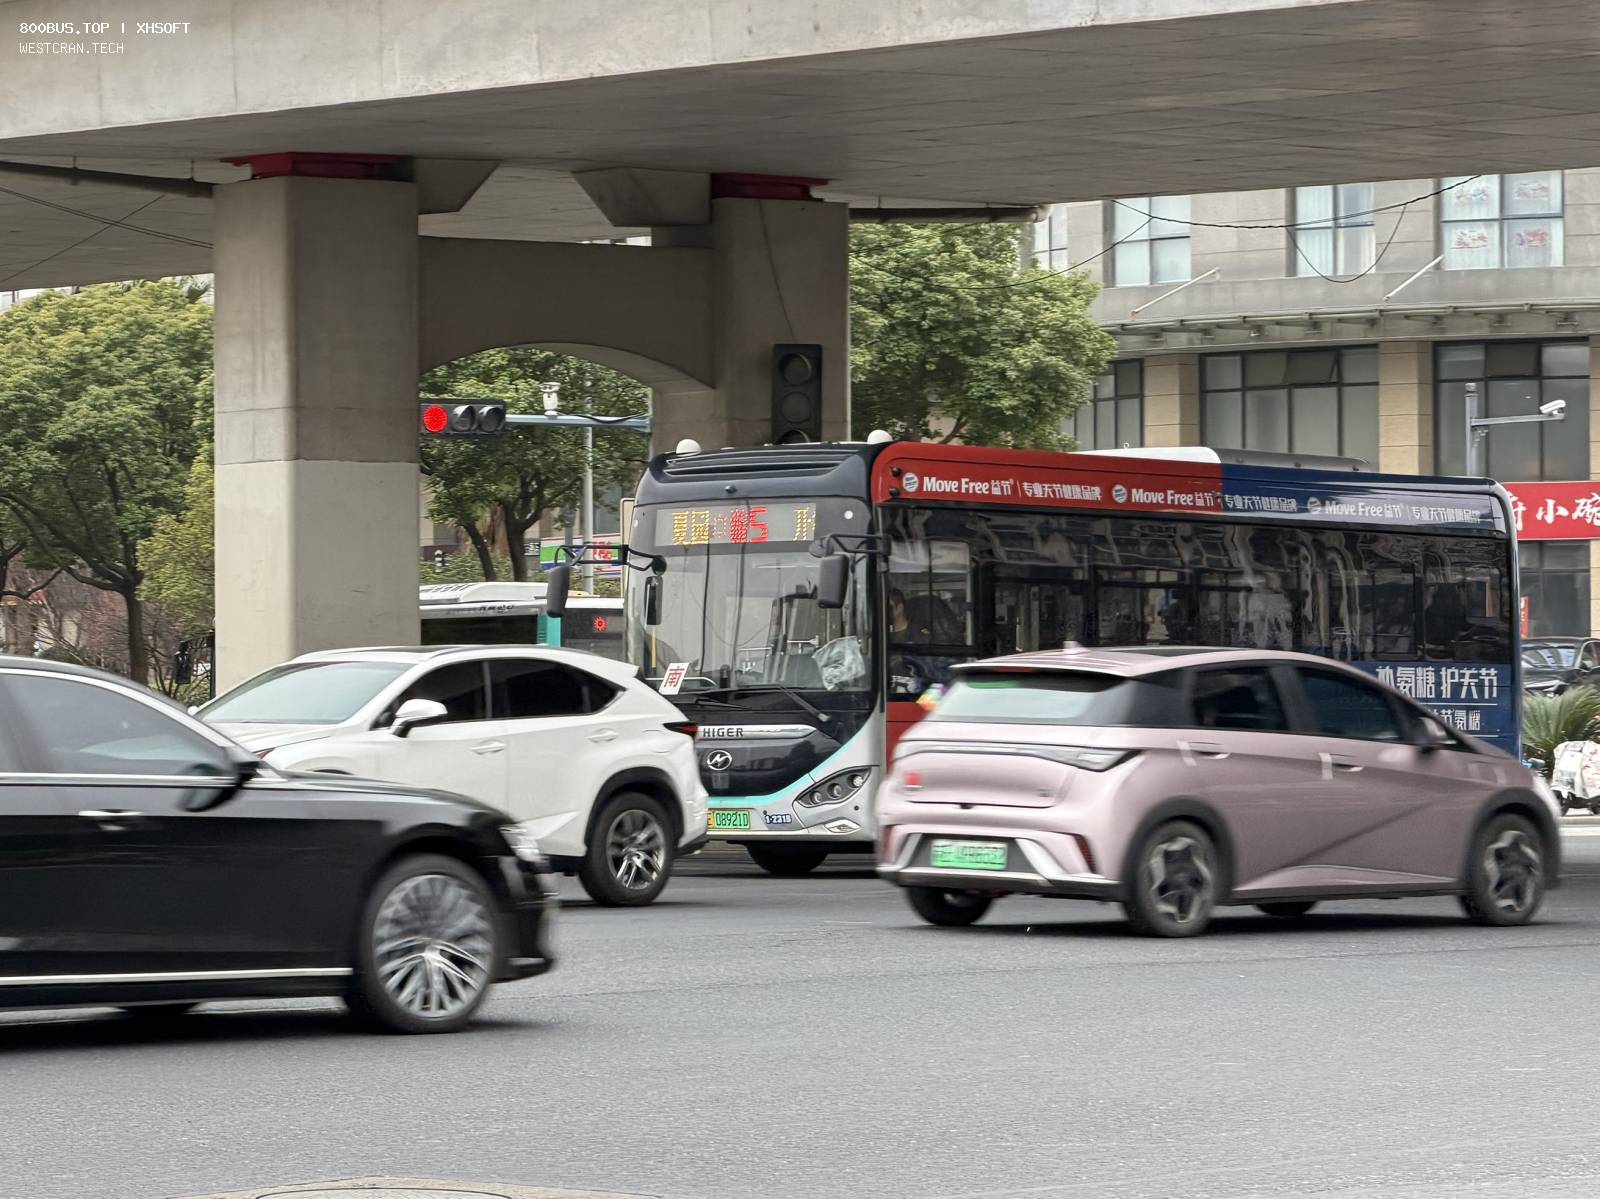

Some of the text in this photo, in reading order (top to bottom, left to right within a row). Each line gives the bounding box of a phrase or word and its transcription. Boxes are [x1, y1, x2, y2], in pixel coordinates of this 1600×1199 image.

[922, 476, 958, 492] Move
[961, 478, 990, 494] Free
[1131, 488, 1164, 504] Move
[1167, 490, 1194, 506] Free
[1325, 500, 1357, 516] Move
[1358, 502, 1383, 517] Free
[664, 665, 685, 688] 南
[1440, 666, 1498, 699] 护关节
[1430, 708, 1481, 731] 节氨糖
[703, 727, 744, 738] HIGER
